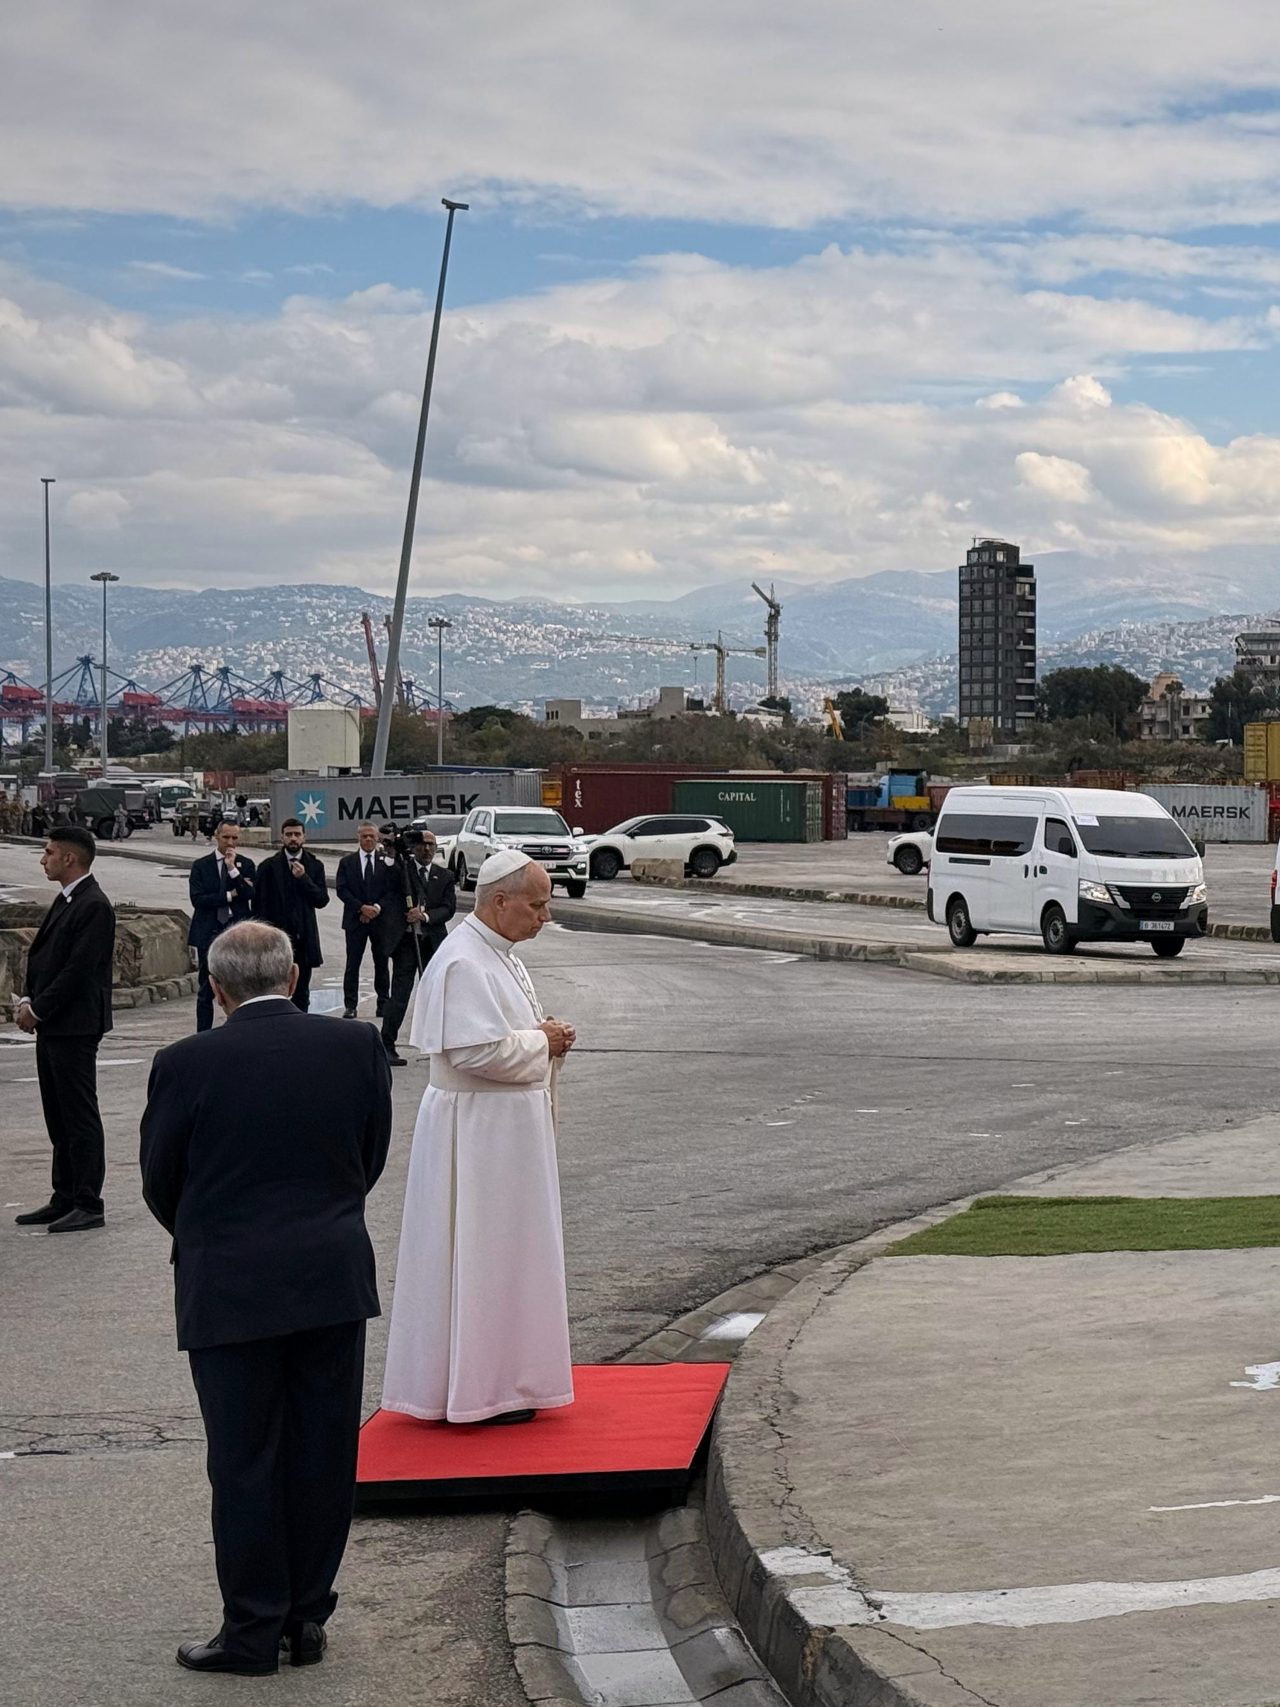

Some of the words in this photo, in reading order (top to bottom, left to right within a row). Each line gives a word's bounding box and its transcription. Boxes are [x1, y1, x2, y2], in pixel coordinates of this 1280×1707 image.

[718, 791, 757, 802] CAPITAL
[338, 793, 480, 820] MAERSK
[1171, 805, 1251, 820] MAERSK
